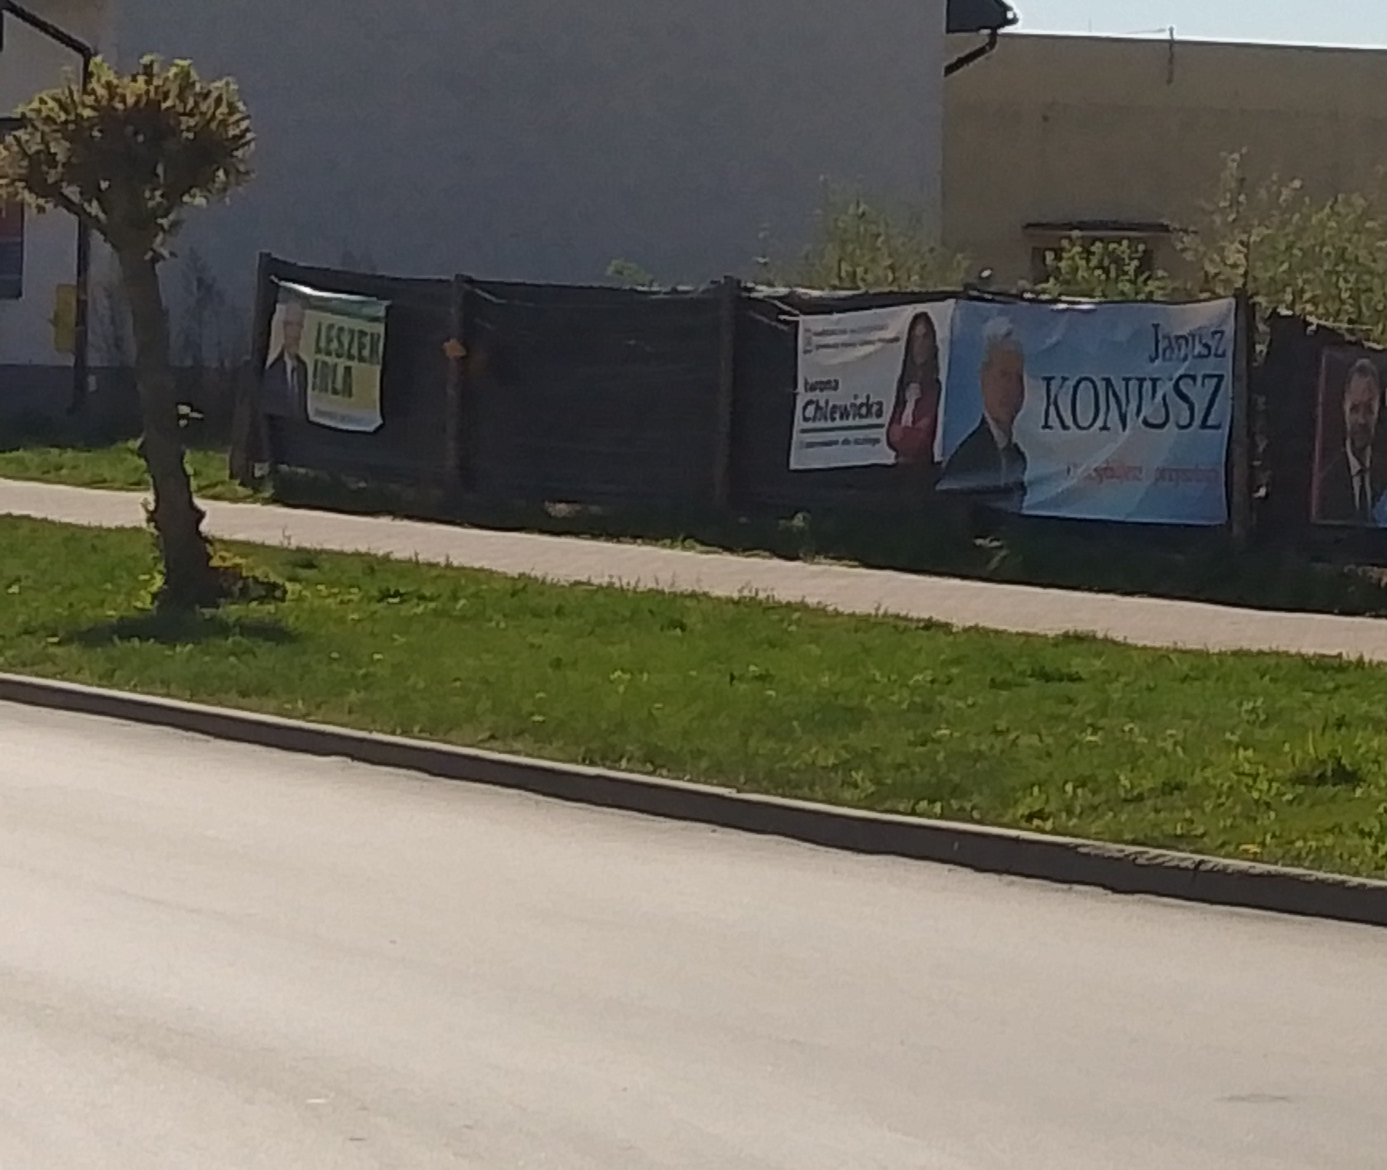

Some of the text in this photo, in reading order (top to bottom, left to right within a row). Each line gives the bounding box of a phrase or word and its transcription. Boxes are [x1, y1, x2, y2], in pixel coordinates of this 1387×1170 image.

[314, 320, 382, 366] LESZEK
[1148, 322, 1227, 363] Janusz
[1040, 373, 1226, 432] KONIUSZ
